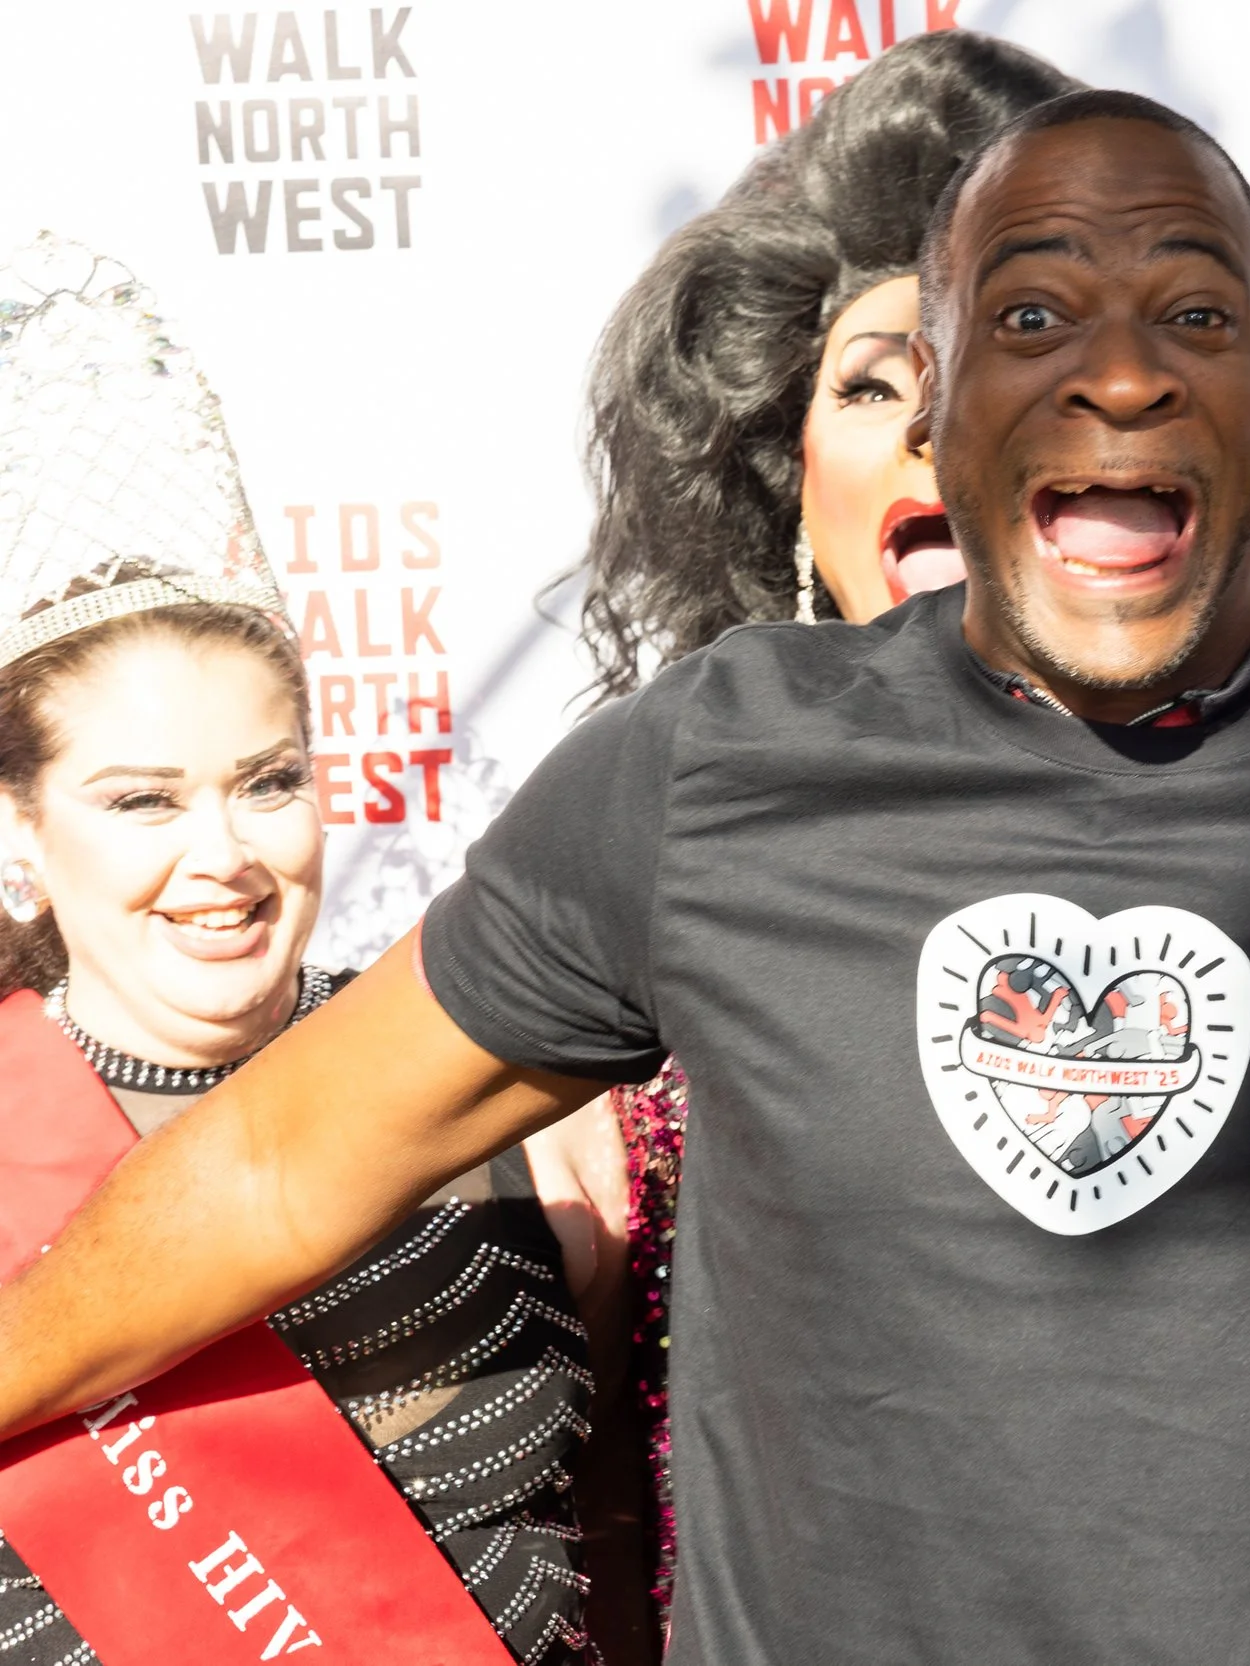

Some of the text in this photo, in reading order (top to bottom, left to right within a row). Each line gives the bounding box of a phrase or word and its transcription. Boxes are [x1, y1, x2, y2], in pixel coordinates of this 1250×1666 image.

[188, 6, 418, 84] WALK
[195, 94, 421, 165] NORTH
[201, 175, 422, 255] WEST
[281, 586, 448, 659] ALK
[318, 670, 455, 738] RTH
[314, 747, 455, 826] EST
[976, 1051, 1011, 1070] AIDS
[1017, 1061, 1056, 1077] WALK
[1062, 1068, 1148, 1086] NORTHWEST
[188, 1530, 322, 1662] HIV
